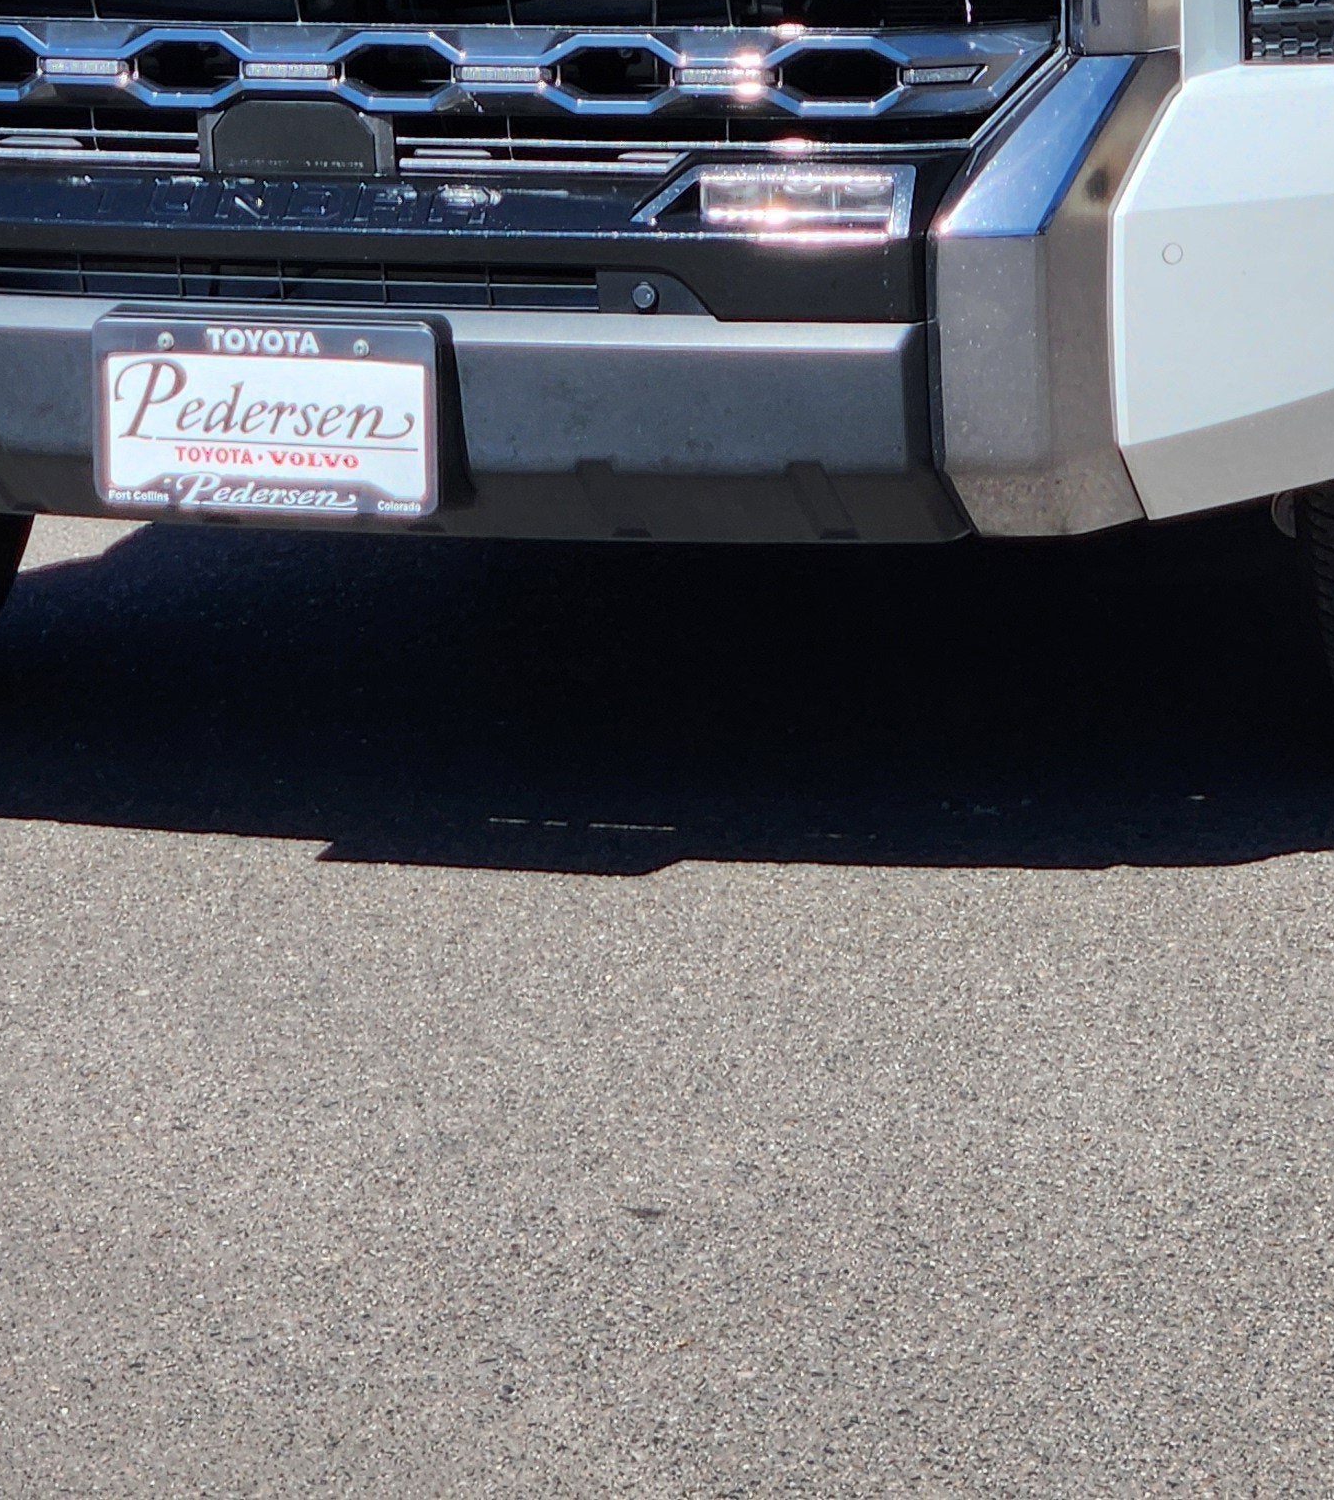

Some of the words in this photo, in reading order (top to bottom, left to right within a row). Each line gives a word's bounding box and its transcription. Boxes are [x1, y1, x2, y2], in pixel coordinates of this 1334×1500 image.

[61, 176, 503, 226] TUNDRA
[207, 328, 320, 355] TOYOTA
[114, 357, 416, 441] Pedersen
[175, 446, 254, 465] TOYOTA
[271, 451, 359, 469] VOLVO
[108, 490, 131, 501] Fort
[133, 490, 169, 502] Collins
[176, 473, 358, 508] Pedersen
[377, 500, 421, 512] Colorado
